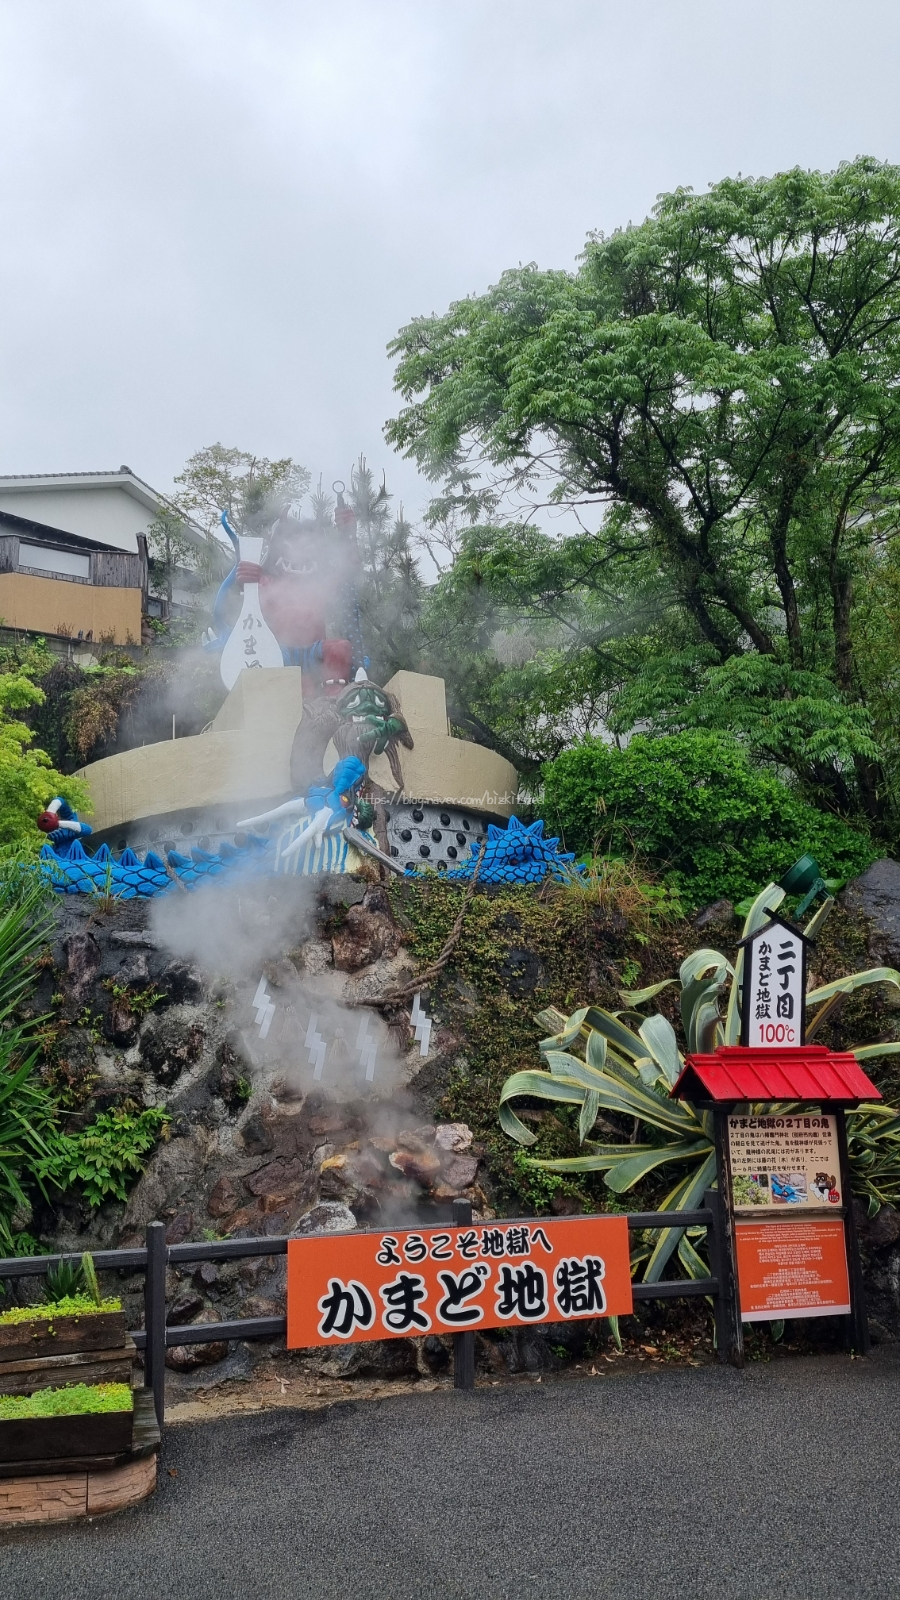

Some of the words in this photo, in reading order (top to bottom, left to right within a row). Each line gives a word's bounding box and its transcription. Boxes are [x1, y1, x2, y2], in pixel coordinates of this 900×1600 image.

[755, 940, 773, 1020] かまど地獄
[776, 940, 797, 1020] 二丁目
[758, 1023, 796, 1043] 100℃
[729, 1117, 830, 1130] かまど地獄の2丁目の鬼
[376, 1226, 553, 1265] ようこそ地獄へ
[320, 1257, 607, 1338] かまど地獄
